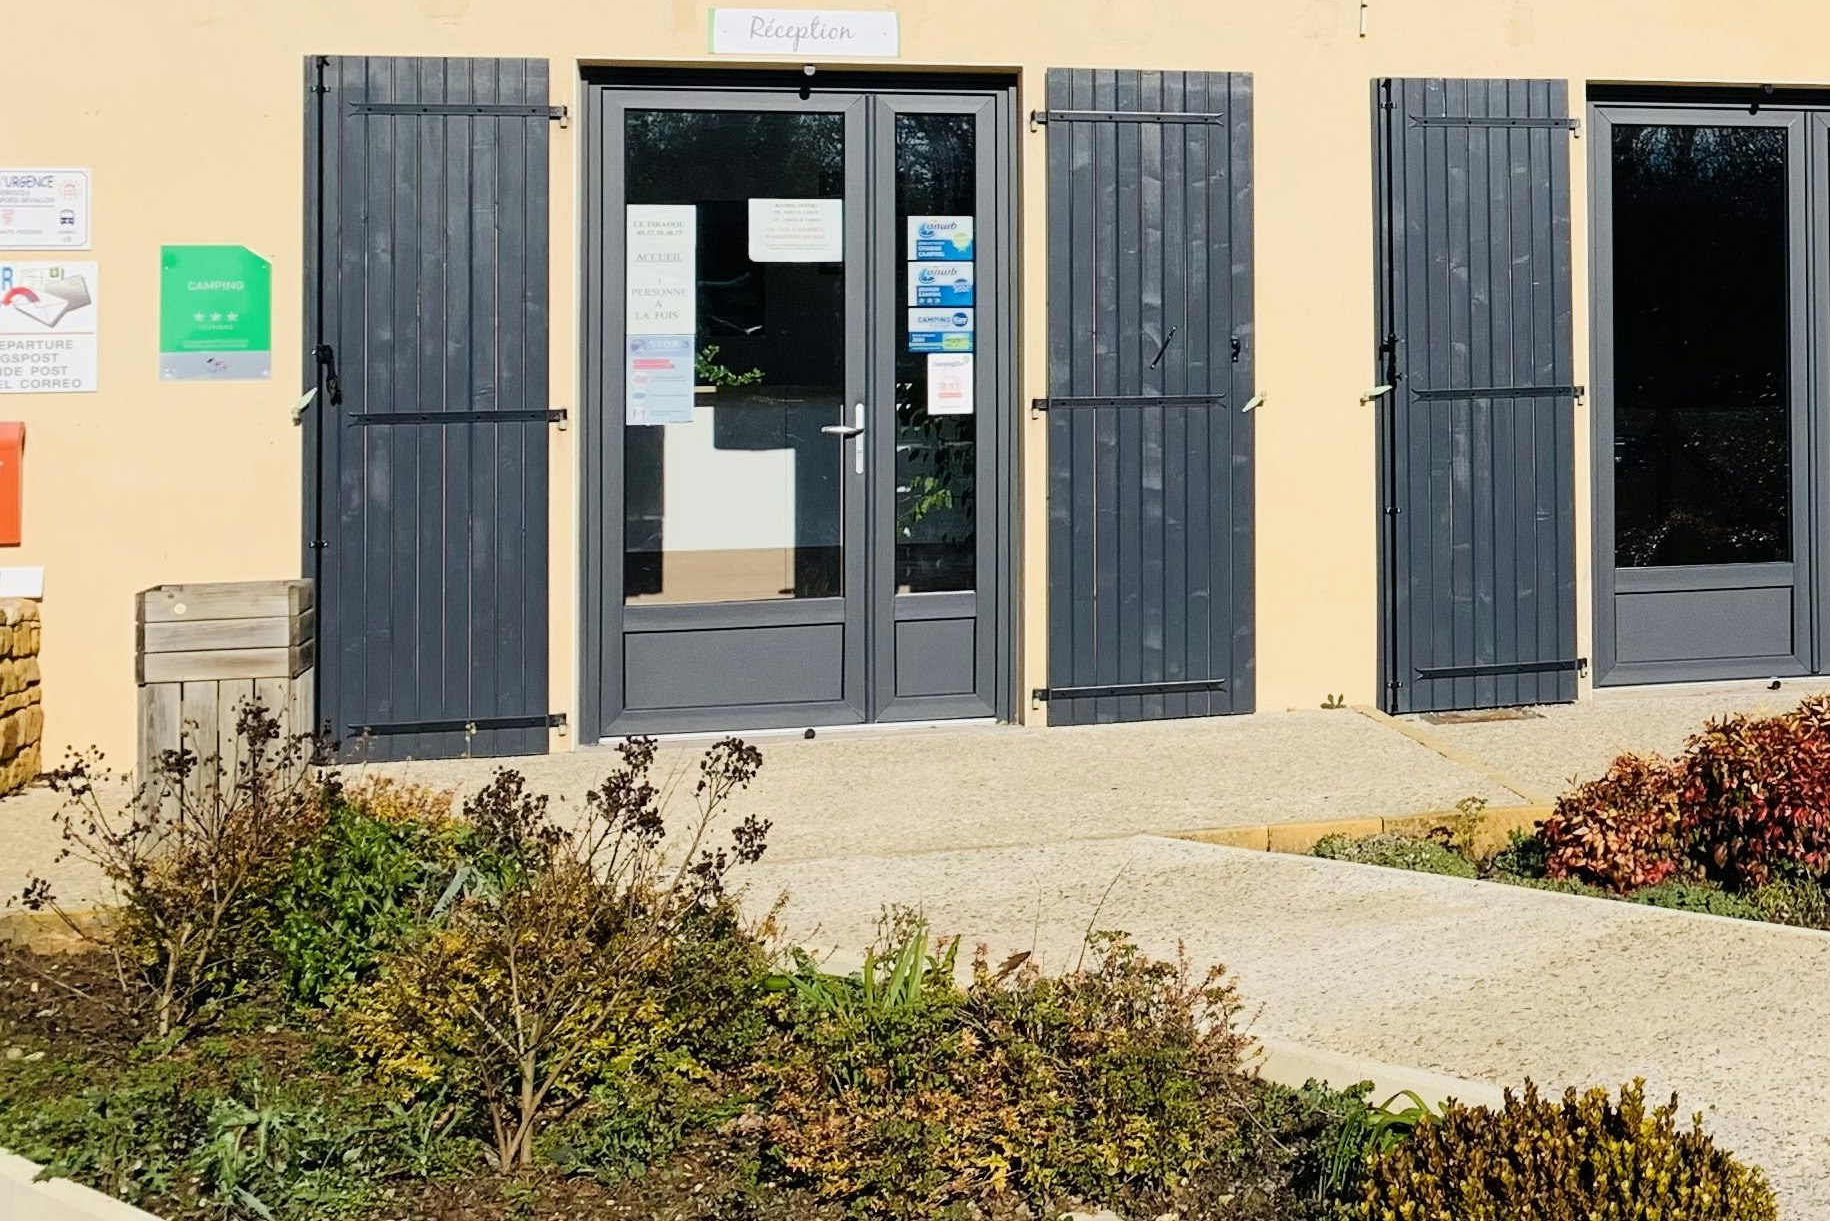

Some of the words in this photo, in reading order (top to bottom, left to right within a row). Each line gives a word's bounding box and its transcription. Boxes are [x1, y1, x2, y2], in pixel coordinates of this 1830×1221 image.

[750, 15, 856, 52] Réception
[0, 175, 54, 188] 'URGENCE
[636, 252, 684, 262] ACCUEIL
[188, 280, 244, 291] CAMPING
[631, 288, 687, 297] PERSONNE
[635, 312, 650, 320] LA
[655, 311, 679, 320] FOIS
[31, 366, 68, 376] POST
[20, 379, 82, 389] CORREO
